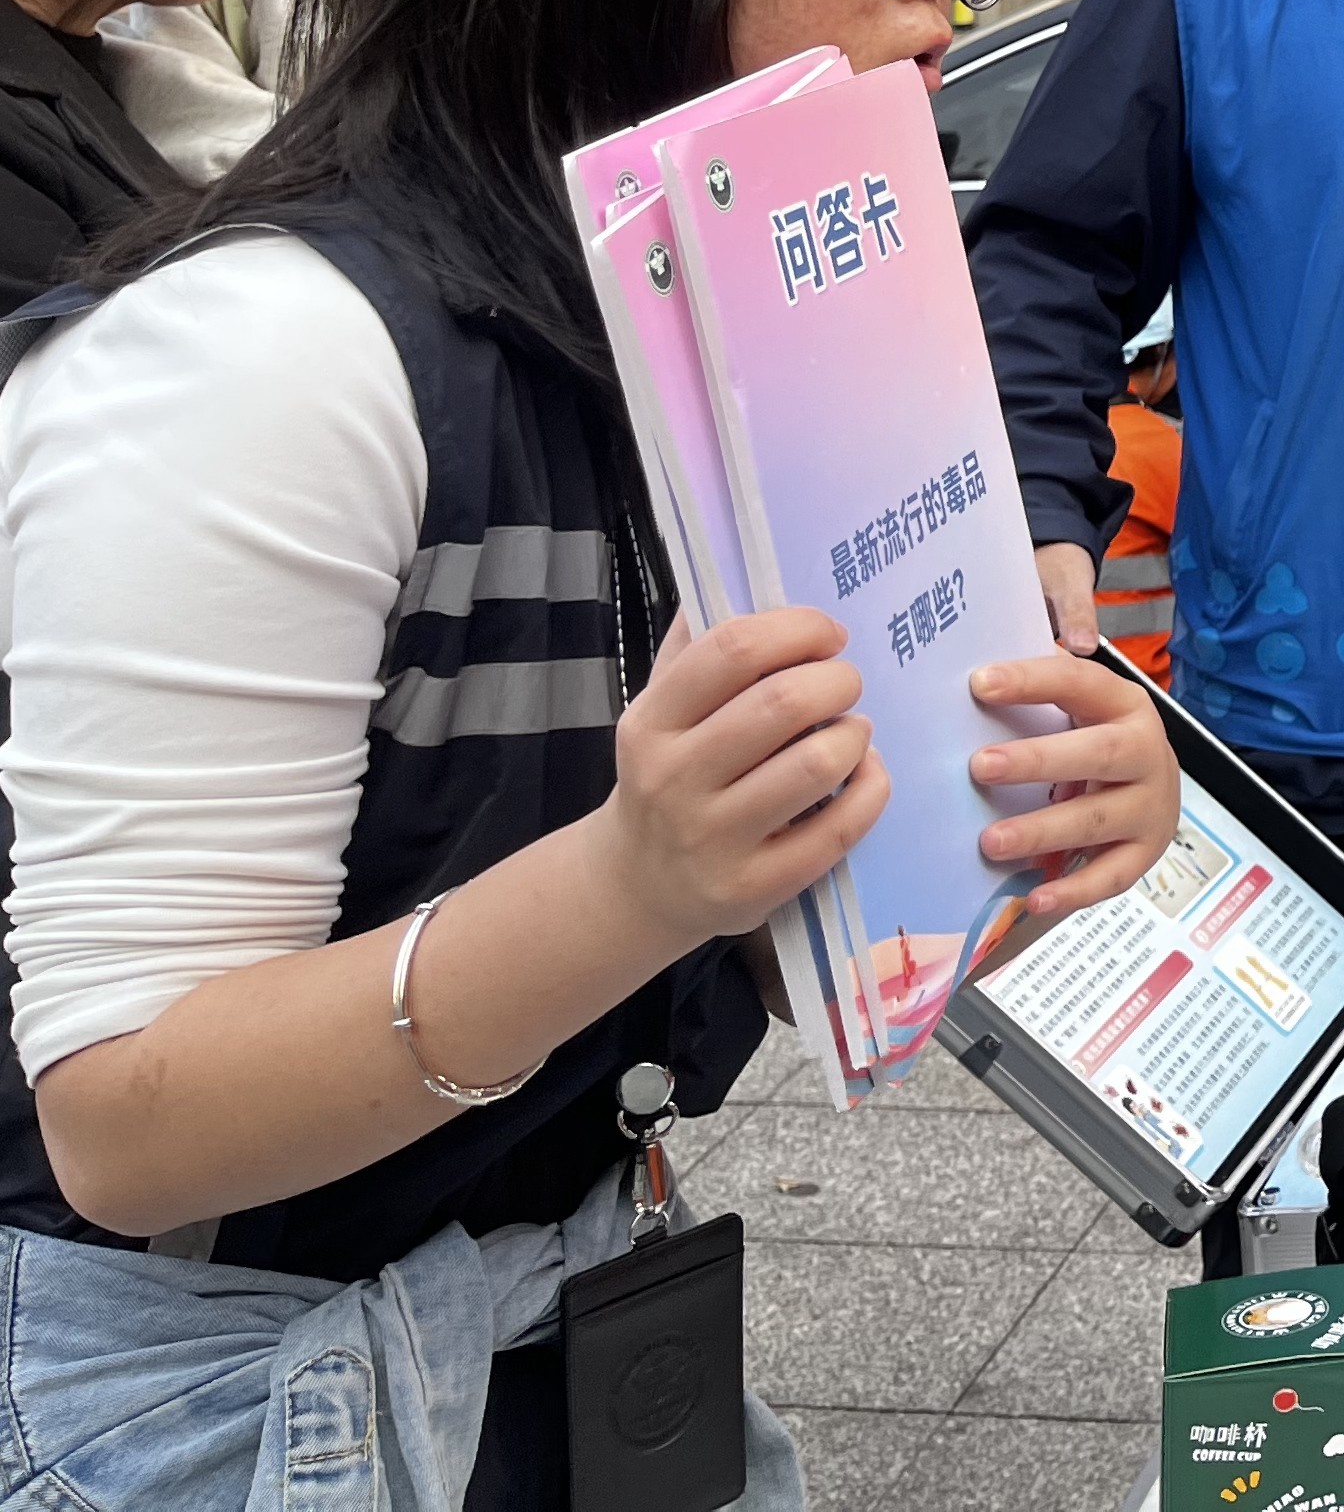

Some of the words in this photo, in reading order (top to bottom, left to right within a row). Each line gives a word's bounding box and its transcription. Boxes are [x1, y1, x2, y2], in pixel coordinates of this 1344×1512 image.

[770, 174, 904, 305] 问答卡
[830, 449, 987, 601] 最新流行的毒品
[887, 568, 967, 668] 有哪些?
[1189, 1421, 1268, 1448] 咖啡杯
[1192, 1448, 1237, 1462] COFFEE
[1236, 1450, 1263, 1462] CUP
[1293, 1492, 1338, 1512] WAN
